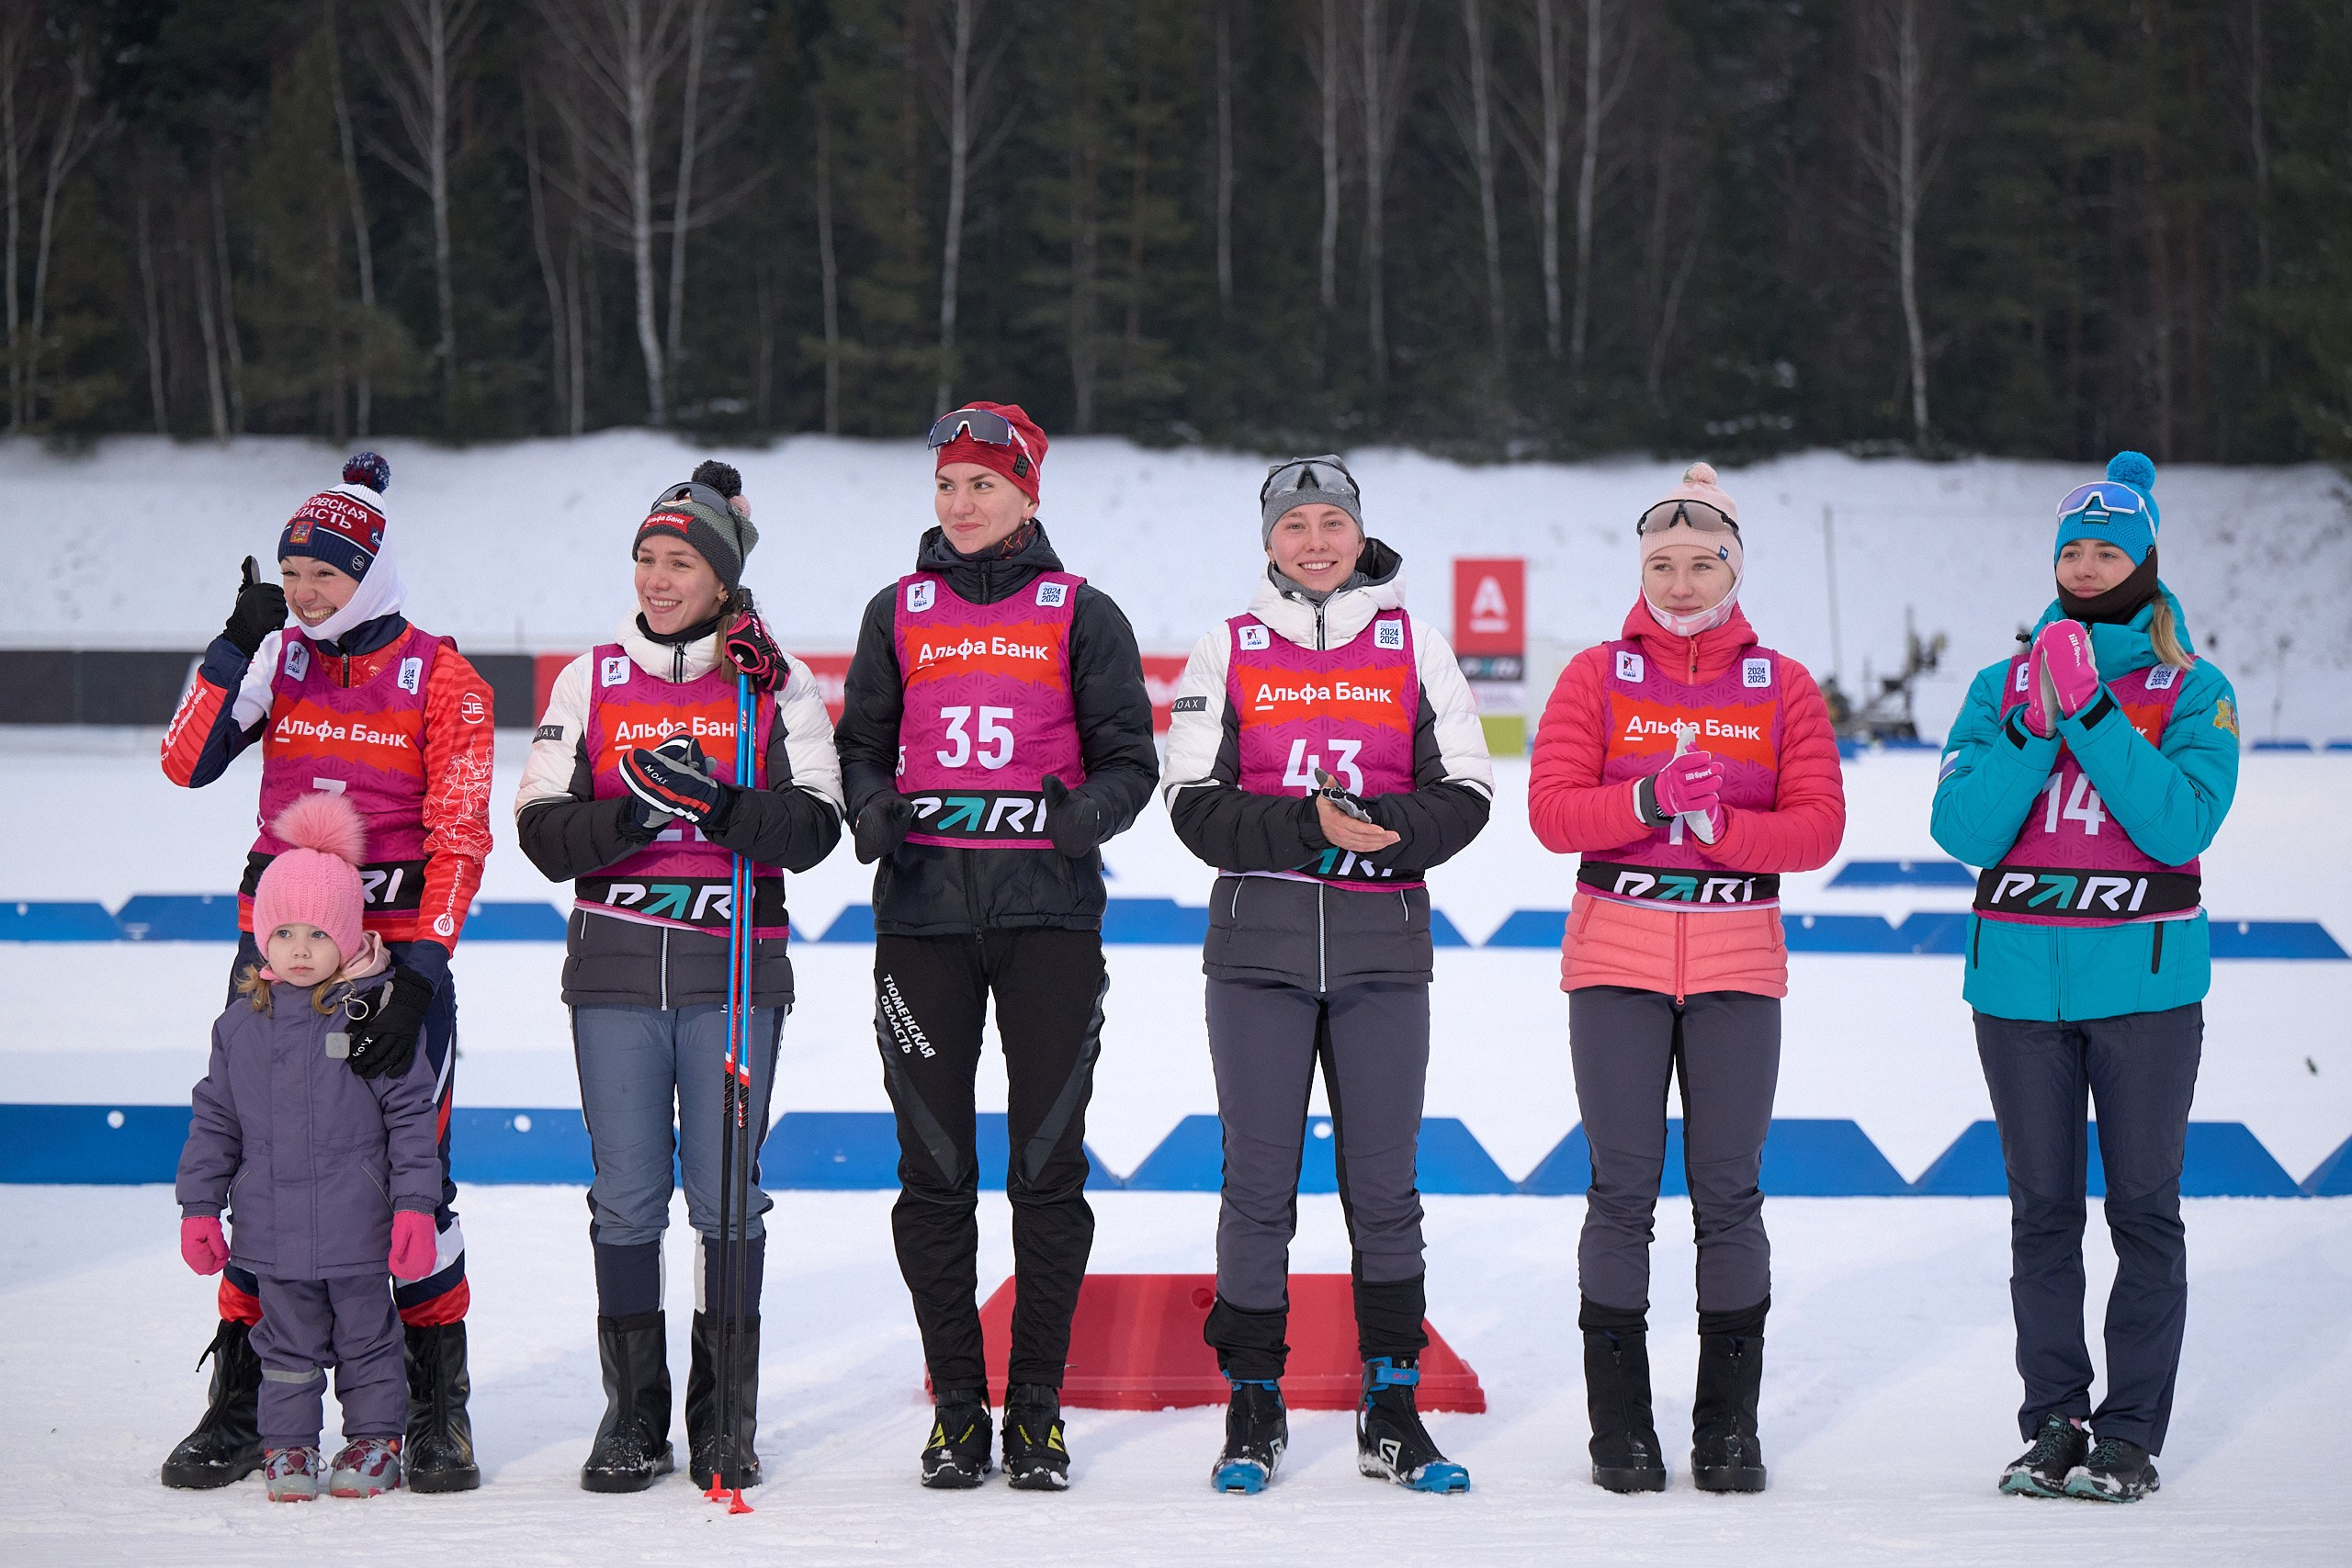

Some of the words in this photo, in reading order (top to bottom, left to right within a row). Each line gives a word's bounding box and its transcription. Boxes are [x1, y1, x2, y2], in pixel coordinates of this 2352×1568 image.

[307, 497, 368, 524] ОВСКАЯ
[1041, 594, 1060, 603] 2025
[1042, 587, 1061, 595] 2024
[1380, 627, 1399, 637] 2024
[1380, 636, 1399, 645] 2025
[919, 637, 987, 663] Альфа
[992, 637, 1048, 660] Банк
[1747, 667, 1766, 675] 2024
[1747, 674, 1767, 683] 2025
[1172, 699, 1199, 710] OAX
[1255, 683, 1331, 705] Альфа
[1335, 682, 1393, 704] Банк
[276, 716, 346, 742] Альфа
[350, 723, 409, 749] Банк
[536, 728, 557, 739] OAX
[692, 716, 738, 738] Бан
[936, 705, 1014, 770] 35
[1705, 718, 1761, 741] Банк
[644, 764, 670, 786] MOAX
[1282, 739, 1363, 798] 43
[910, 796, 1047, 833] PARI
[2042, 772, 2107, 836] 14
[360, 868, 404, 904] RI
[1613, 871, 1756, 903] PARI
[1990, 872, 2149, 912] PARI
[605, 883, 757, 920] PAR
[880, 995, 913, 1055] ОБЛАСТЬ
[883, 974, 936, 1059] ТЮМЕНСКАЯ
